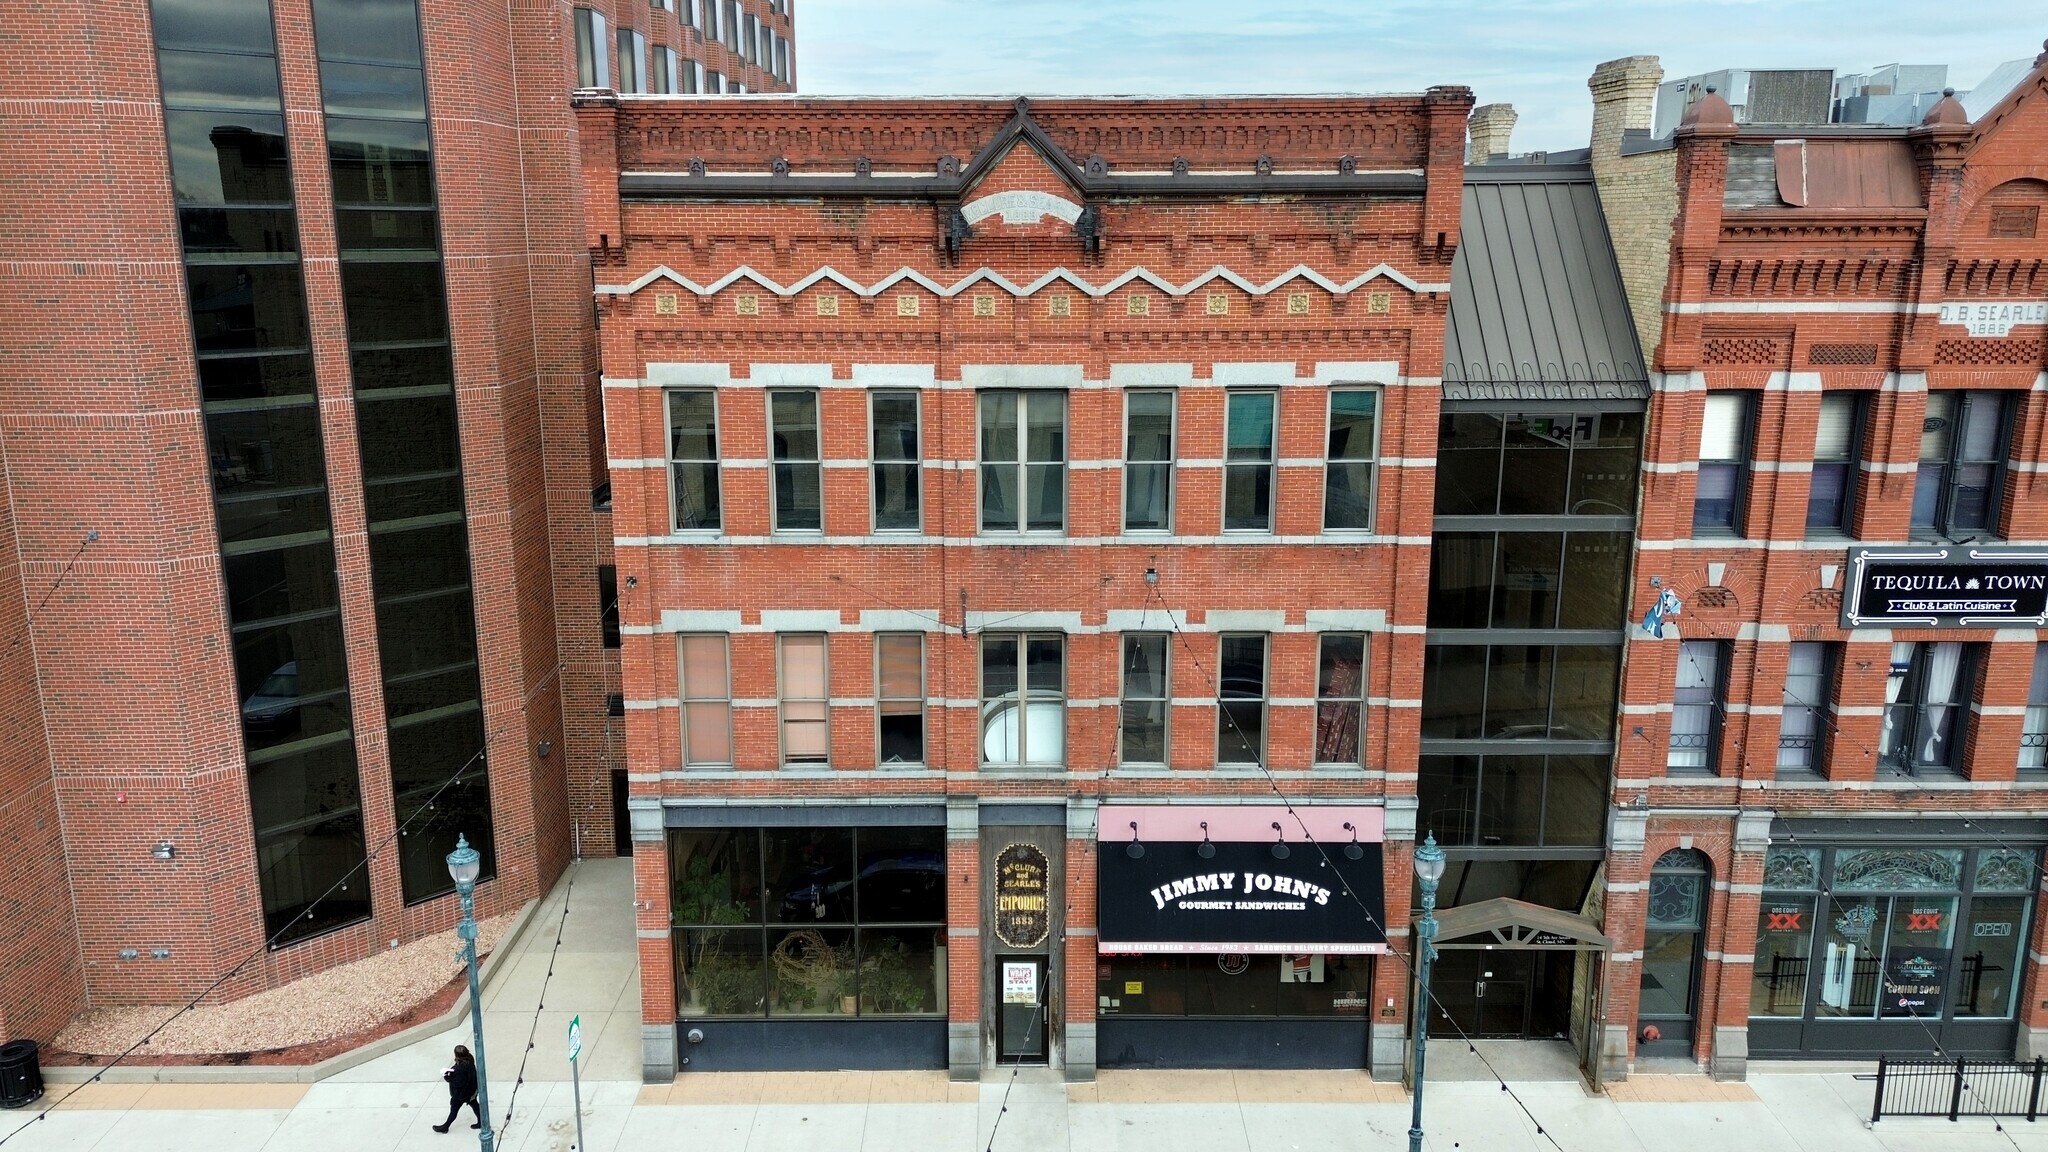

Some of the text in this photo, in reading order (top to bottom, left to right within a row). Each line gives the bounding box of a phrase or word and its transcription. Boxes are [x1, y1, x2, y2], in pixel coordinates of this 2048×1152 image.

[1971, 323, 2006, 335] 1886
[1872, 575, 2046, 591] TEQUILA TOWN
[1902, 602, 2001, 610] Club & Latin Cuisine
[1150, 872, 1332, 910] JIMMY JOHN'S
[999, 895, 1045, 911] EMPORIUM
[1178, 901, 1306, 911] GOURMET SANDWICHES
[1766, 913, 1802, 930] XX
[1906, 913, 1942, 931] XX
[1975, 923, 2010, 936] OPEN
[1254, 944, 1292, 952] SANDWICH
[1294, 944, 1328, 952] DELIVERY
[1888, 985, 1941, 995] COMING SOON
